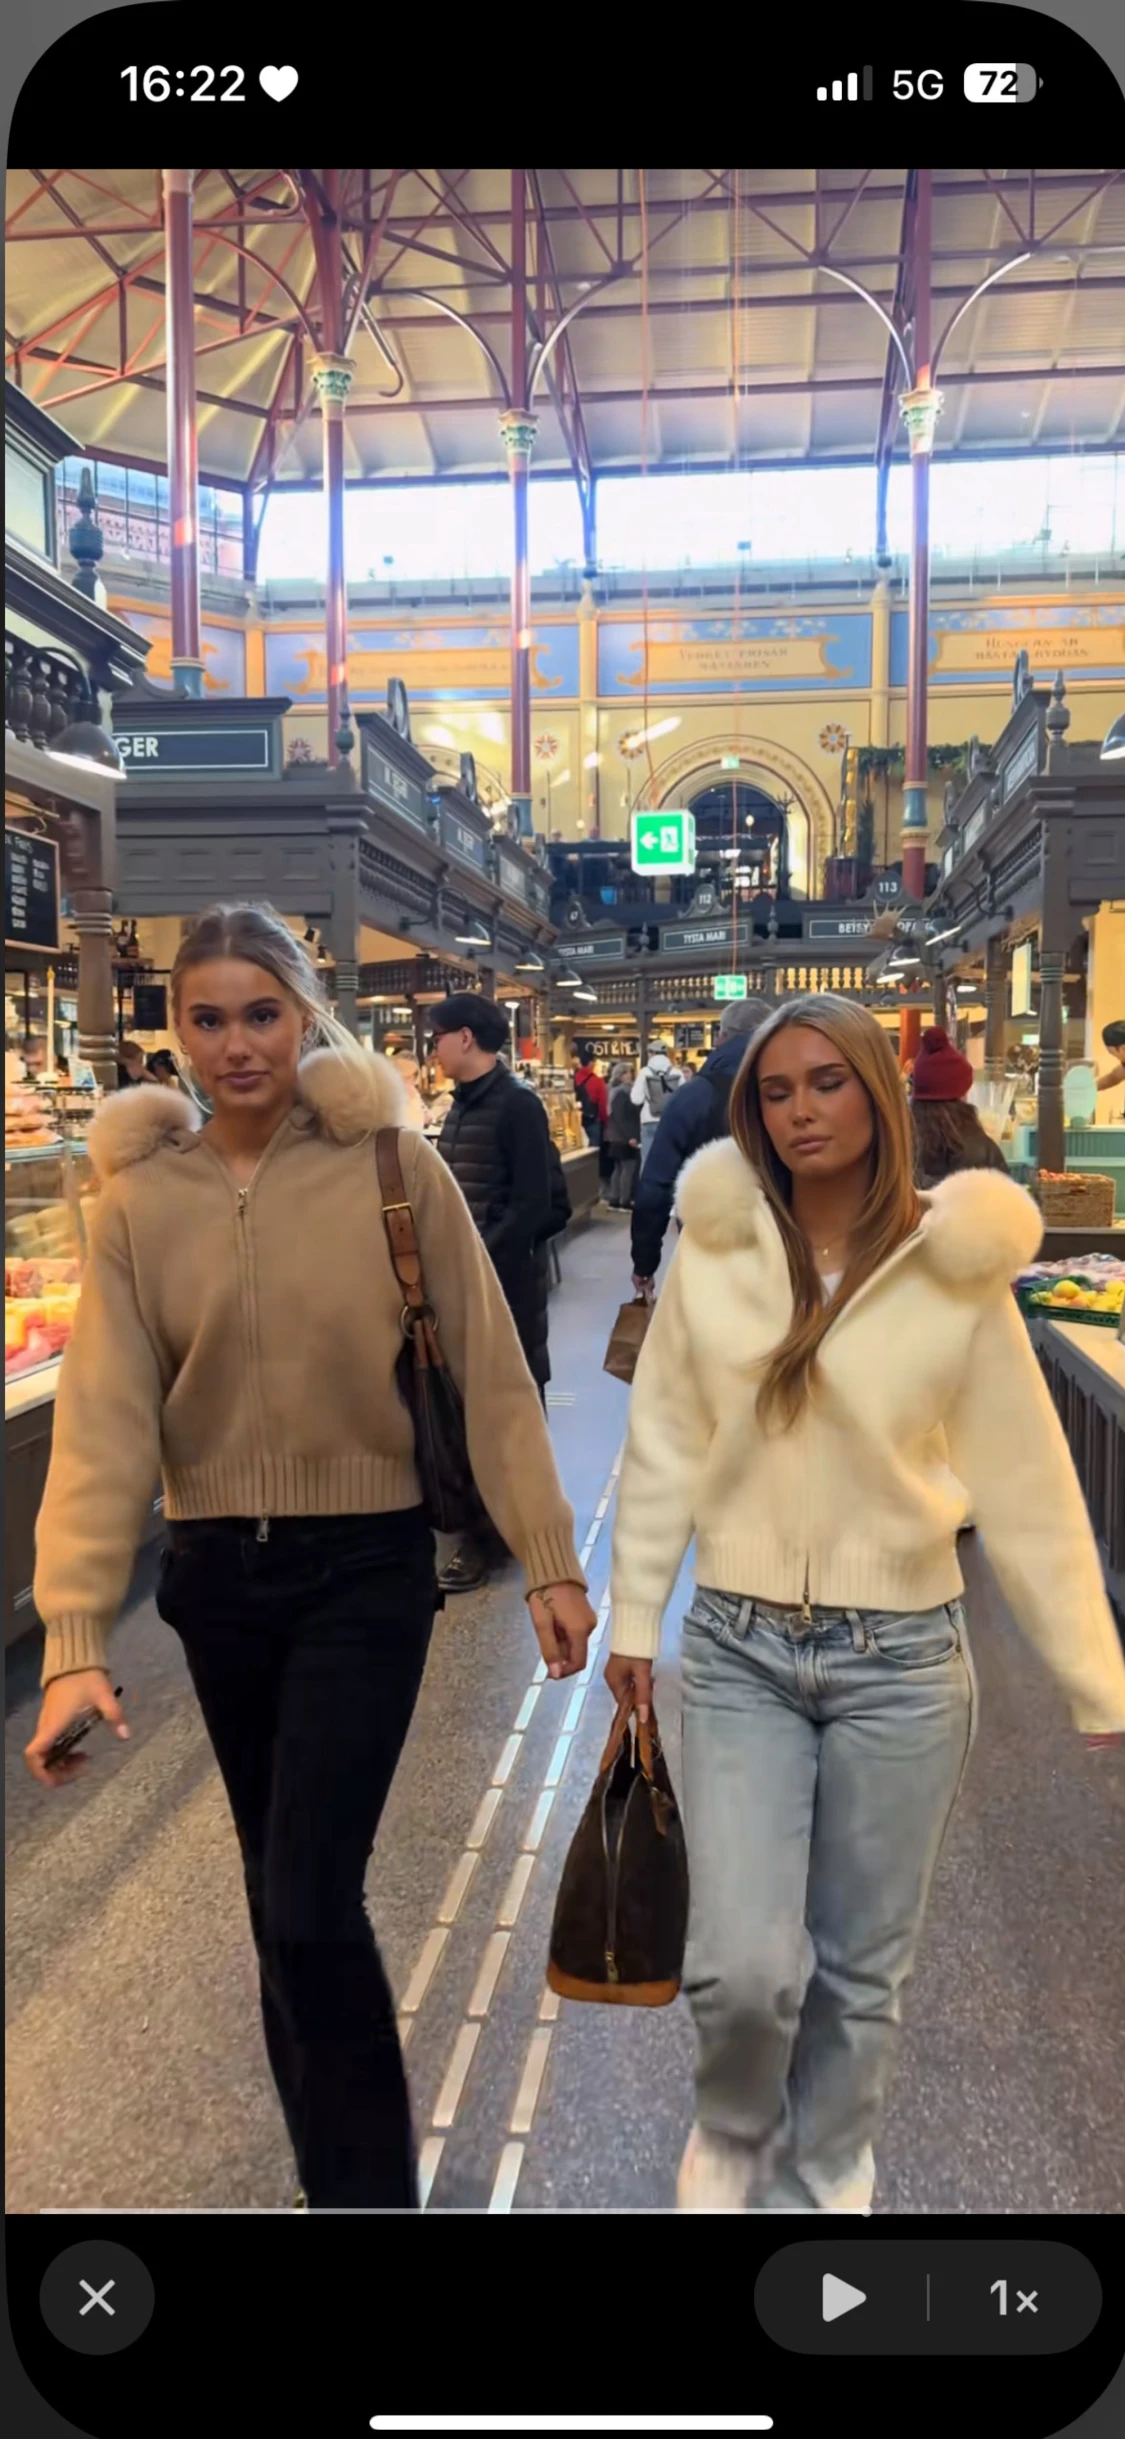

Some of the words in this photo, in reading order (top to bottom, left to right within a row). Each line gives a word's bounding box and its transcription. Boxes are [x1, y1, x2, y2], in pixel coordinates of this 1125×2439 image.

[878, 881, 898, 893] 113
[683, 933, 705, 944] TYSTA
[705, 930, 727, 942] MARI
